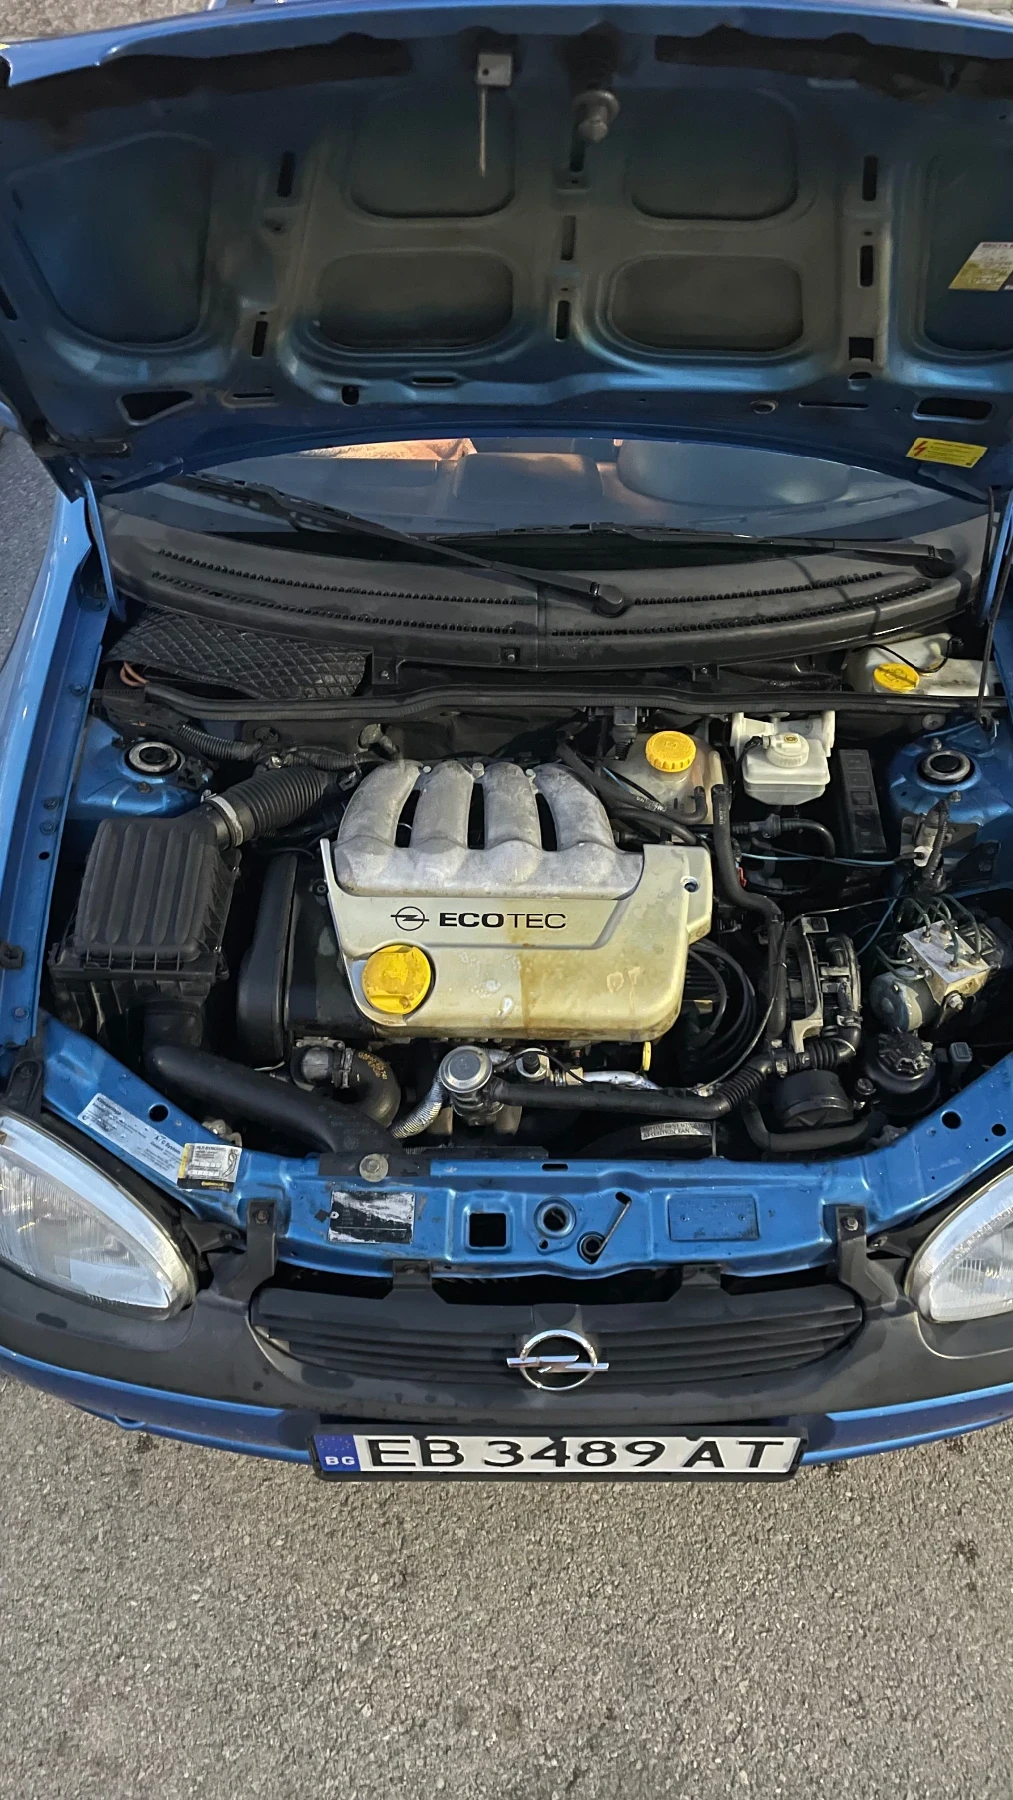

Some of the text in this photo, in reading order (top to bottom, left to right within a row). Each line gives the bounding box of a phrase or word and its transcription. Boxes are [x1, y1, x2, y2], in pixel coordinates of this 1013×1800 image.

[439, 912, 567, 929] ECOTEC
[325, 1455, 356, 1466] BG
[366, 1438, 784, 1468] EB 3489 AT
